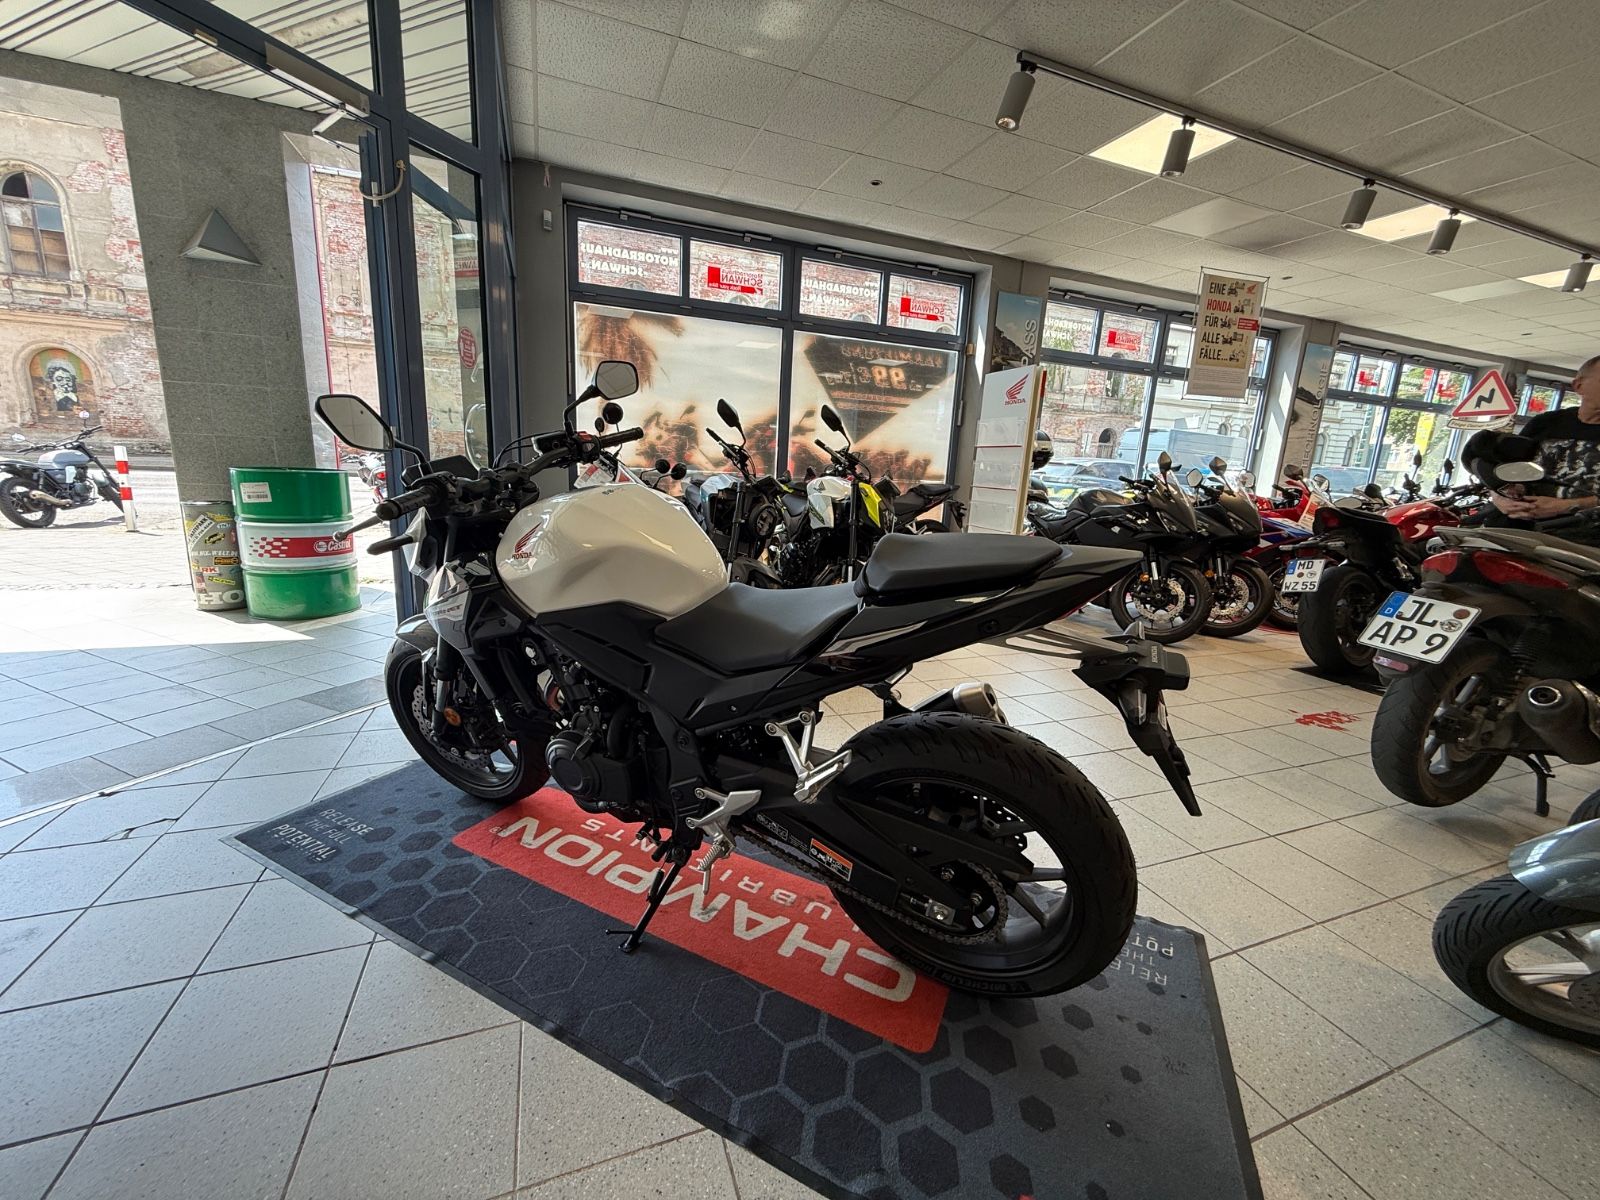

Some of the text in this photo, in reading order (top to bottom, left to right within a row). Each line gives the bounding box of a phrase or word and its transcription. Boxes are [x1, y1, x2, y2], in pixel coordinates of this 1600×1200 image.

[1209, 281, 1227, 295] EINE
[1206, 298, 1232, 313] HONDA
[1204, 312, 1219, 328] FÜR
[1201, 332, 1220, 345] ALLE
[1199, 346, 1228, 361] FÄLLE...
[1004, 398, 1026, 406] HONDA
[512, 551, 533, 560] HONDA
[1297, 561, 1315, 570] MD
[1284, 581, 1318, 591] WZ 55
[1395, 600, 1439, 627] JL
[1367, 620, 1449, 655] AP 9
[319, 808, 375, 836] RELEASE
[304, 818, 352, 845] THE FULL
[271, 823, 337, 860] POTENTIAL
[497, 815, 917, 1003] CHAMPION
